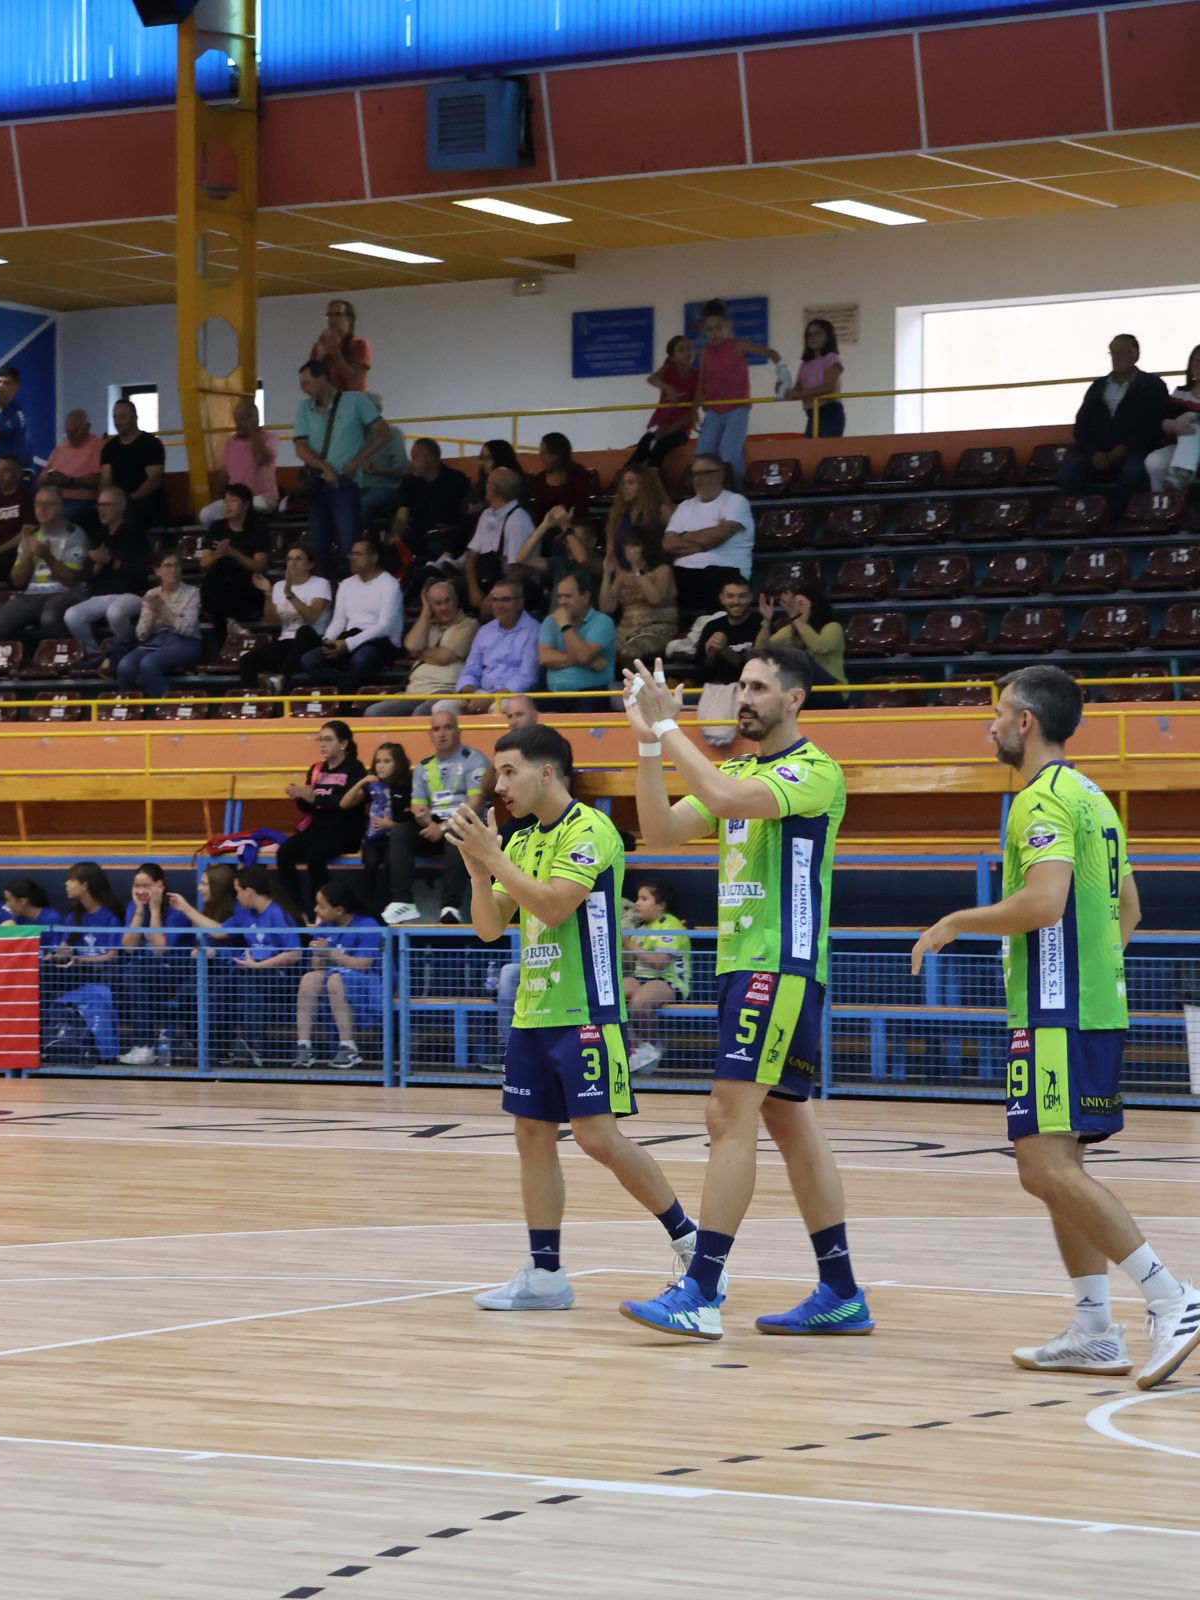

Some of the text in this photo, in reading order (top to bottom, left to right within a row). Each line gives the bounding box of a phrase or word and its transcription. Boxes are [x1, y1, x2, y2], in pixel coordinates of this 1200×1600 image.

[939, 560, 949, 572] 7
[1015, 557, 1027, 571] 9
[1089, 553, 1105, 567] 11
[872, 618, 885, 632] 7
[950, 615, 962, 628] 9
[1048, 928, 1056, 976] IORNO,
[735, 1008, 760, 1044] 5
[581, 1048, 601, 1081] 3
[1006, 1059, 1029, 1098] 19
